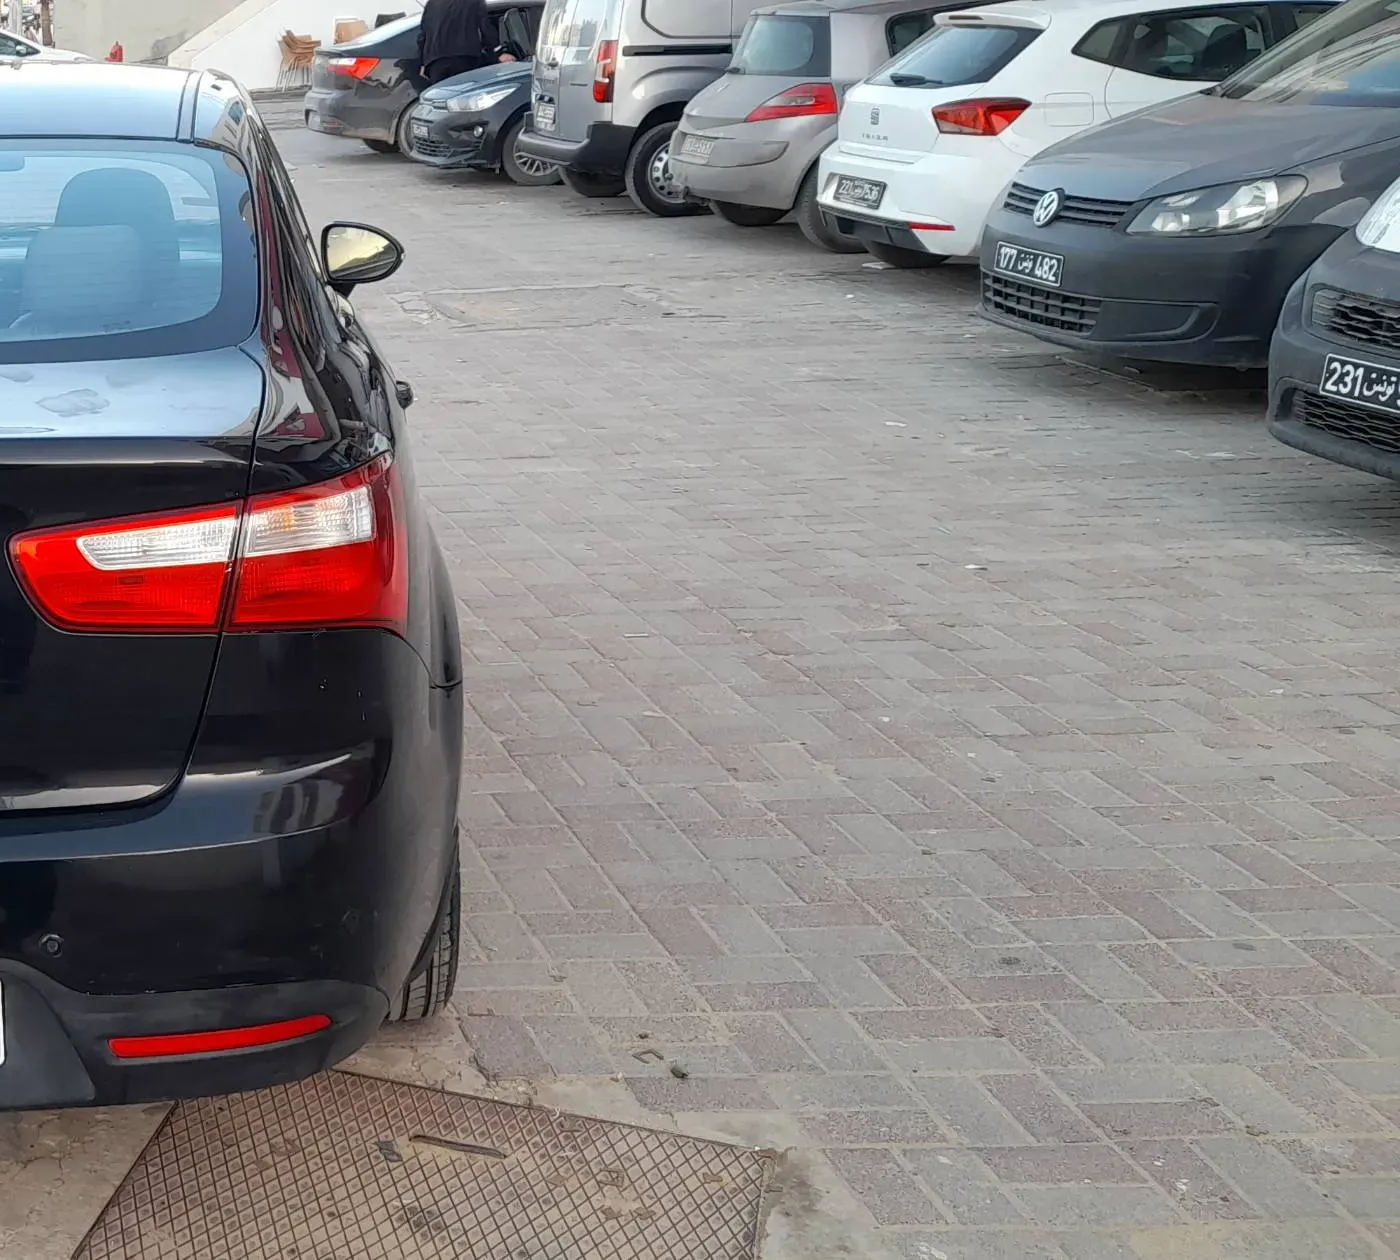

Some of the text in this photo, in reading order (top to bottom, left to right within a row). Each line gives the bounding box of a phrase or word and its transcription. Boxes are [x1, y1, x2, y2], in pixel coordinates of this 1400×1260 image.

[1000, 246, 1018, 270] 177
[1034, 255, 1058, 281] 482
[1325, 361, 1365, 397] 231
[1363, 372, 1397, 401] تونس
